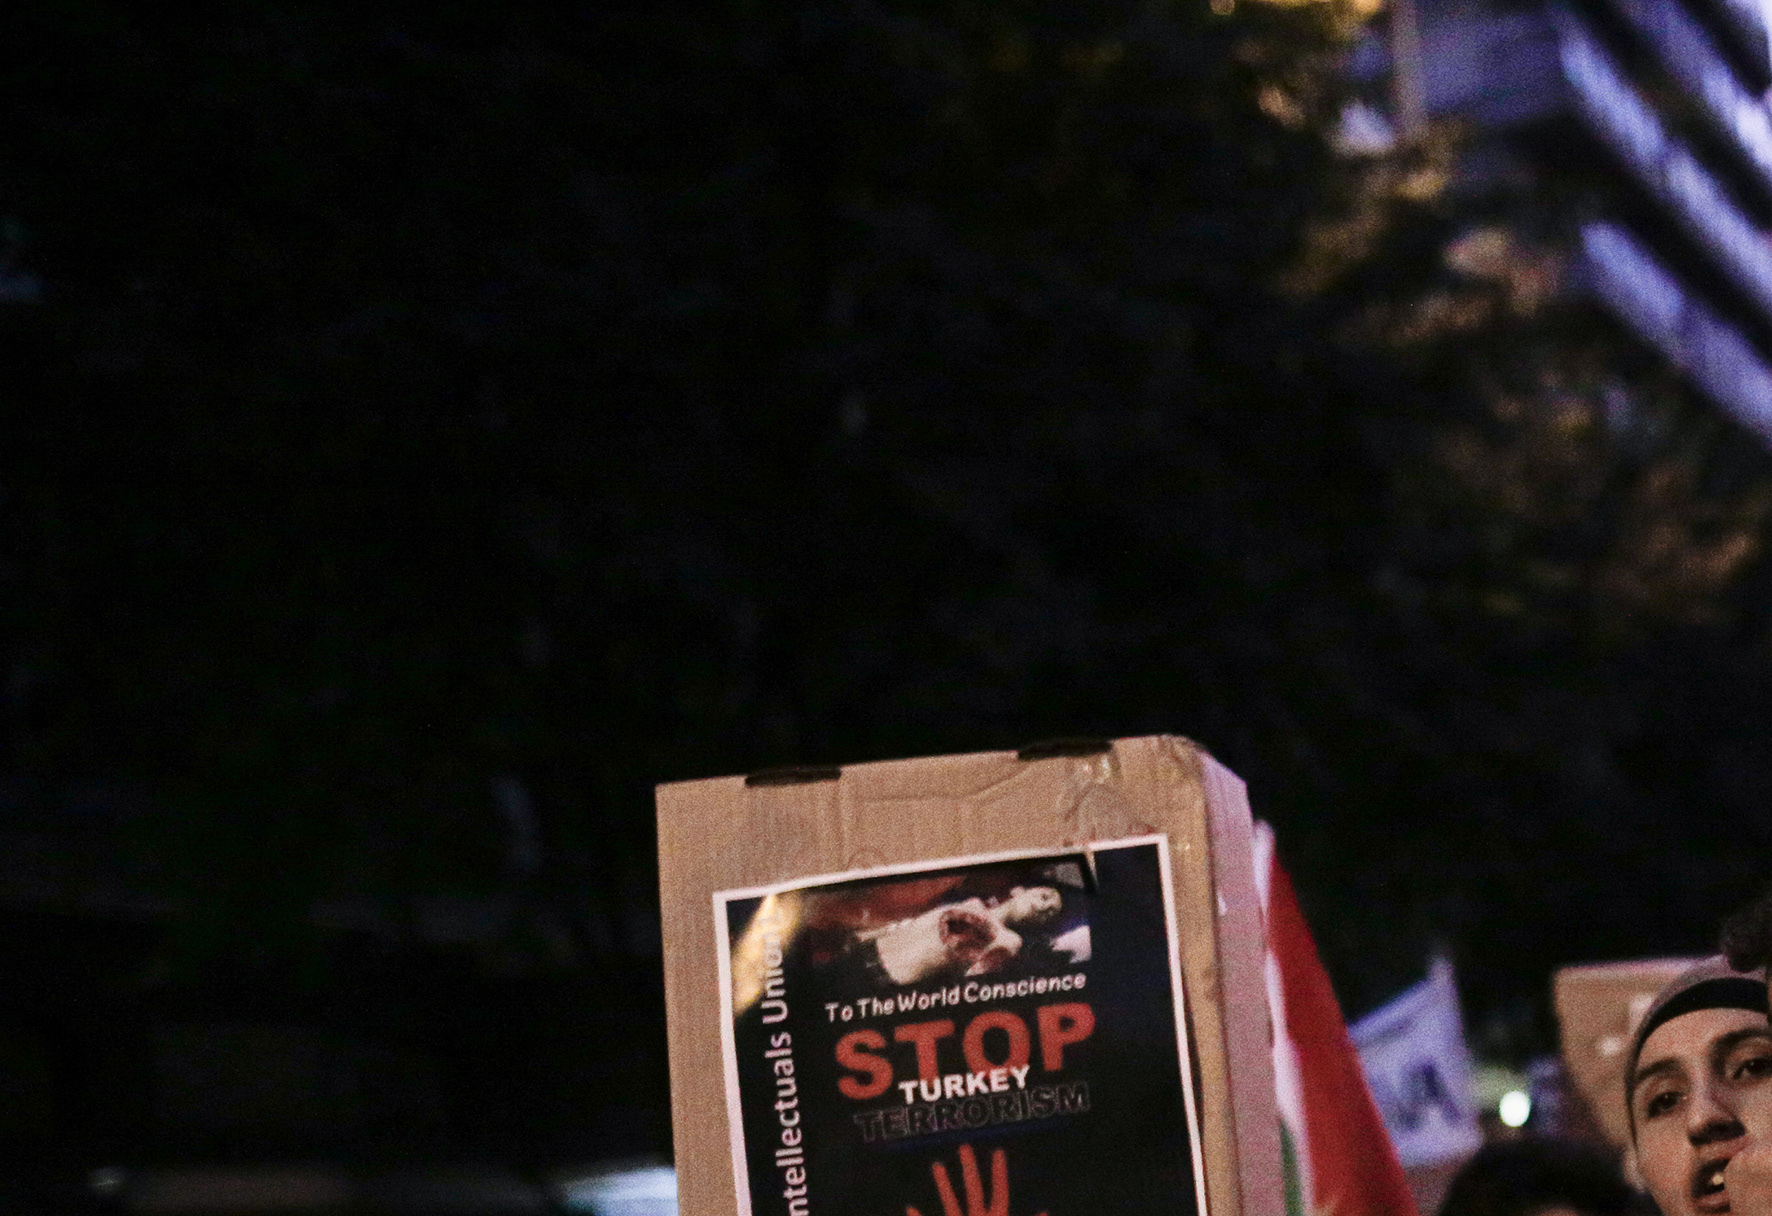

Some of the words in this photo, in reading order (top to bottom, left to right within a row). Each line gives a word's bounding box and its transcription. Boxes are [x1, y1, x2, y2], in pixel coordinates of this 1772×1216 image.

[857, 995, 894, 1017] The
[897, 986, 960, 1011] World
[963, 972, 1087, 1002] Conscience
[835, 1002, 1096, 1100] STOP
[898, 1064, 1030, 1105] TURKEY
[854, 1081, 1091, 1142] TERRORISM
